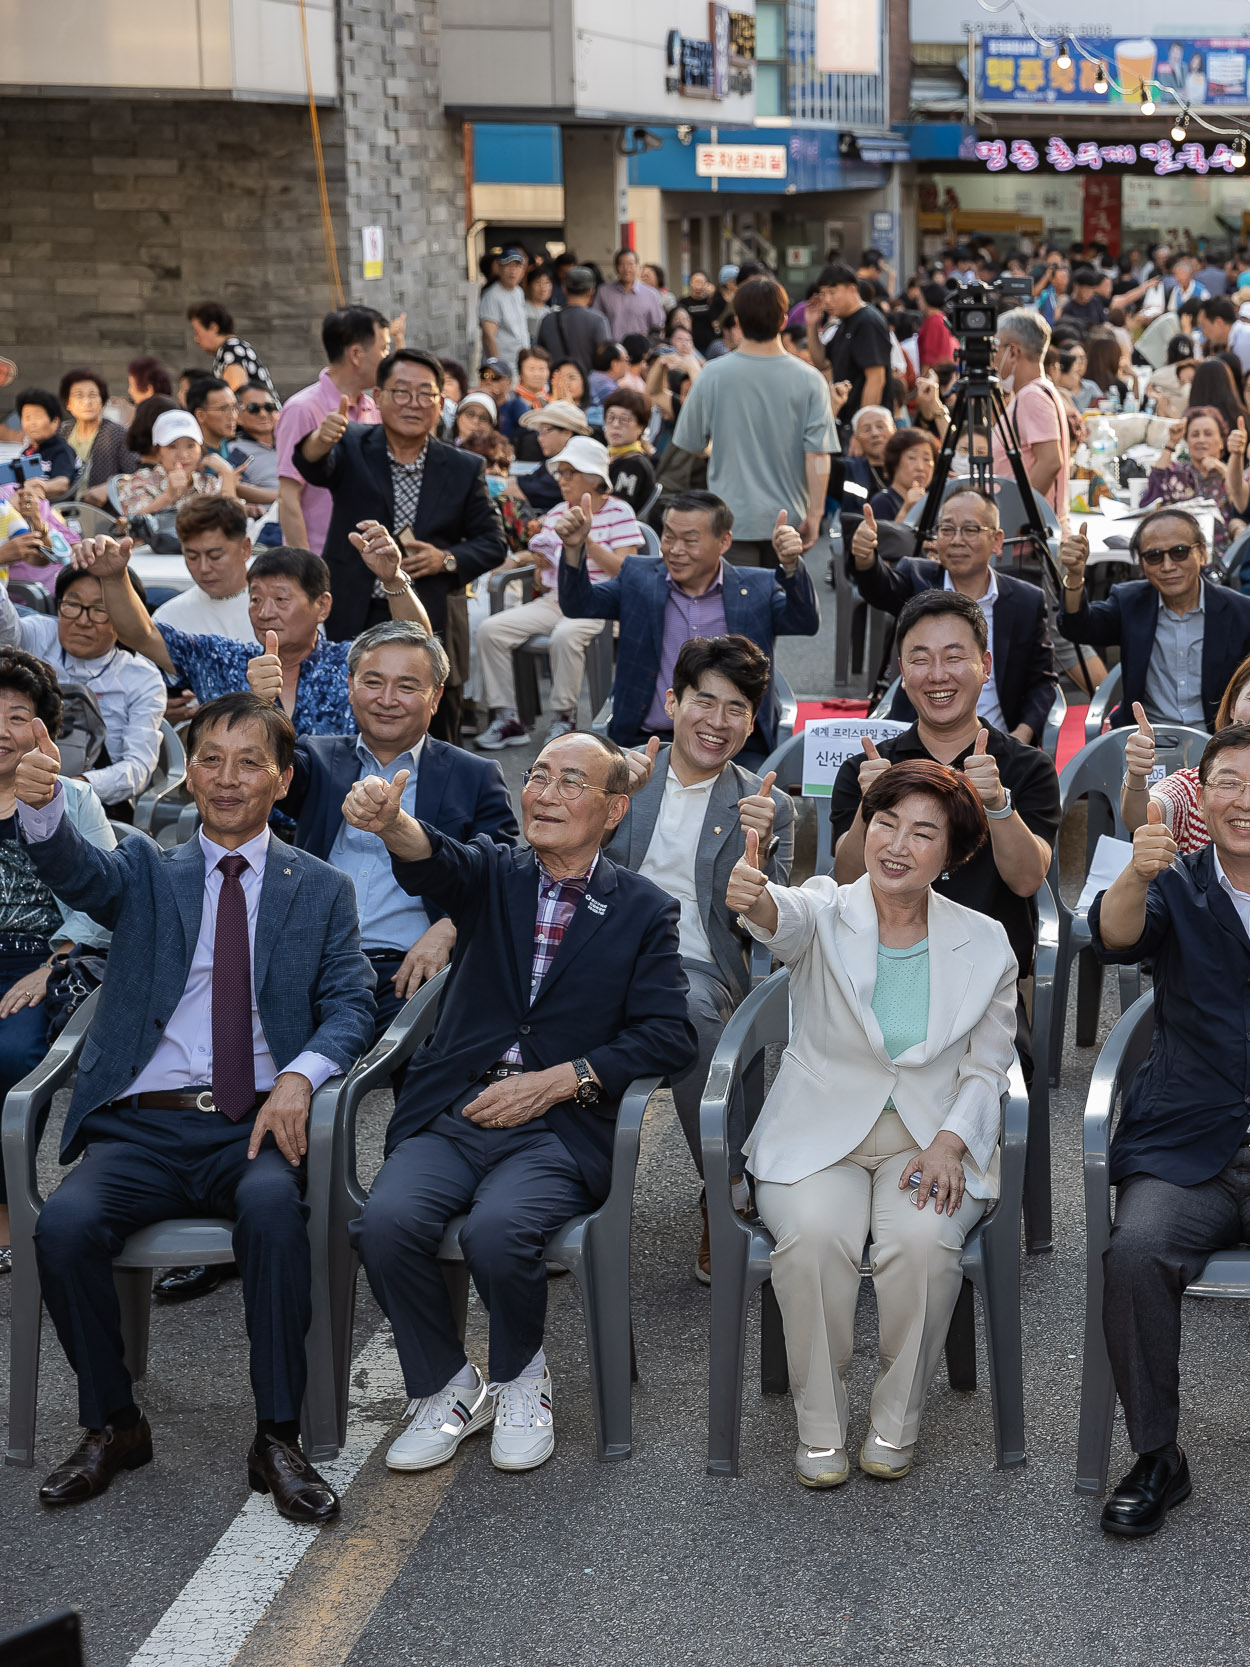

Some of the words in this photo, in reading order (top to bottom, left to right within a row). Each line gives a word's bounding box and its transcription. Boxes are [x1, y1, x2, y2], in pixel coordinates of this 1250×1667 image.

[702, 151, 783, 170] 주차관리실
[810, 727, 829, 738] 세계
[832, 727, 878, 739] 프리스타일
